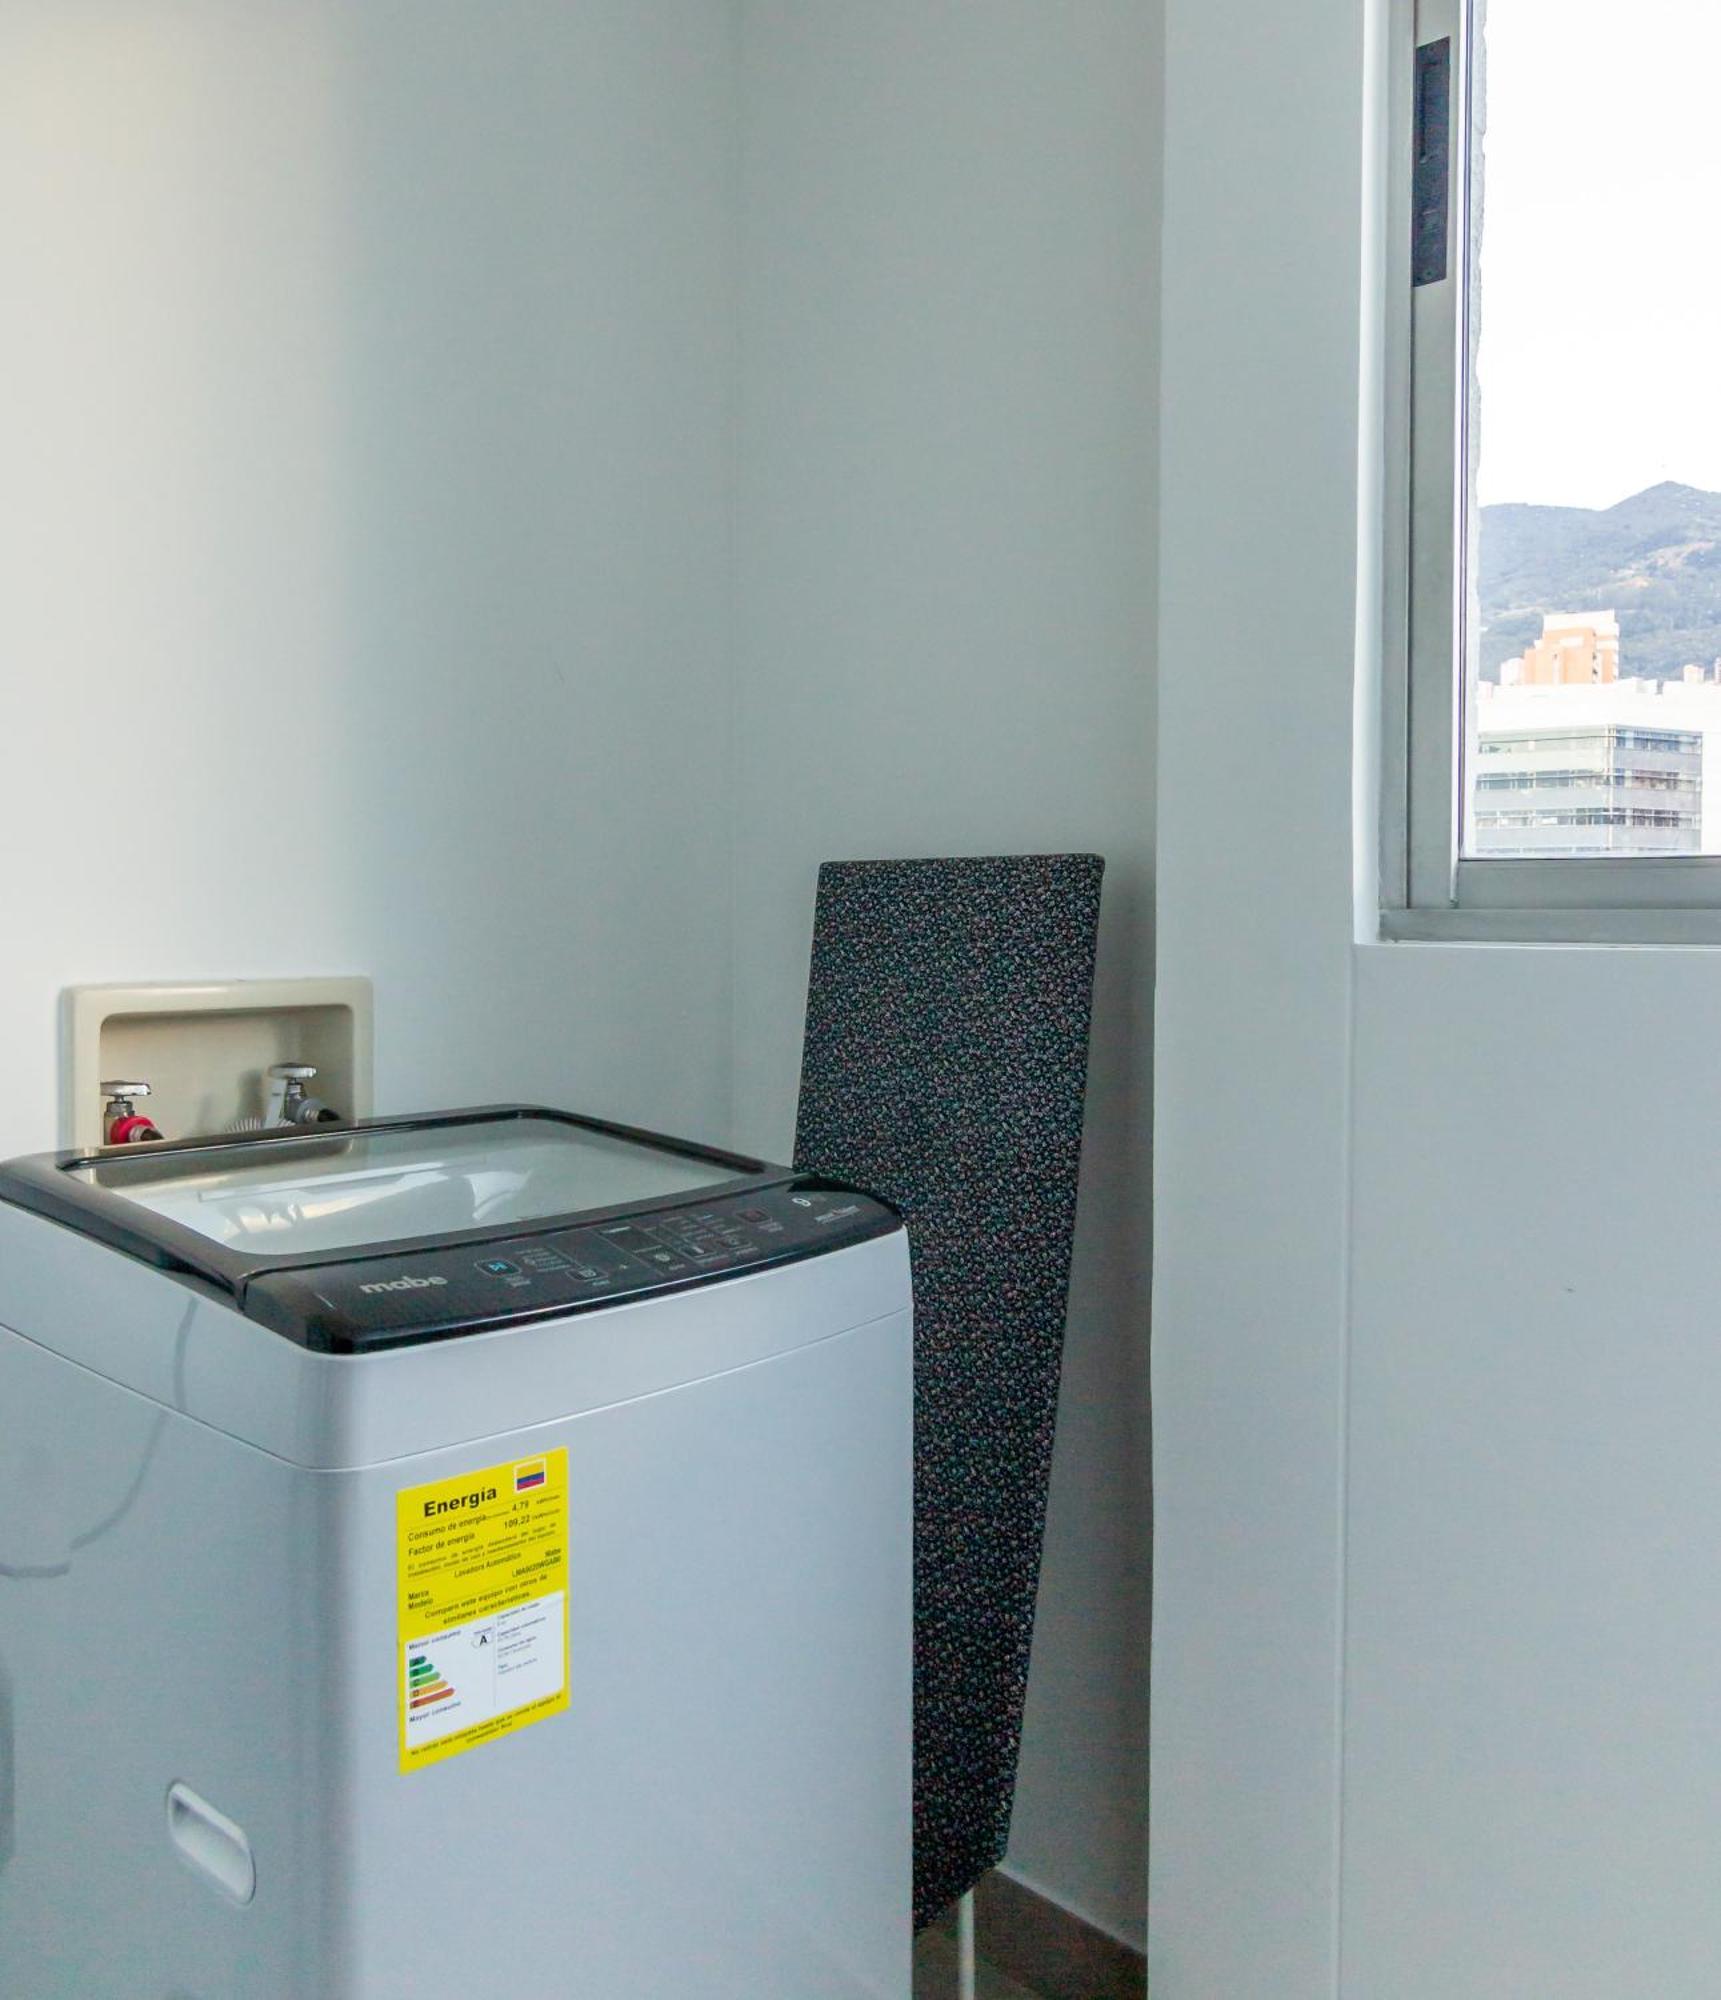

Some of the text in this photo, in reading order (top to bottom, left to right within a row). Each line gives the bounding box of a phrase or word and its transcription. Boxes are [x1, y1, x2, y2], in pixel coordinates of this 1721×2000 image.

[359, 1274, 449, 1294] mabe
[408, 1526, 446, 1542] Consumo
[448, 1522, 457, 1531] de
[409, 1543, 433, 1557] Factor
[436, 1540, 445, 1549] de
[504, 1514, 530, 1529] 109,22
[408, 1590, 429, 1600] Marca
[408, 1598, 433, 1610] Modelo
[479, 1634, 488, 1647] A
